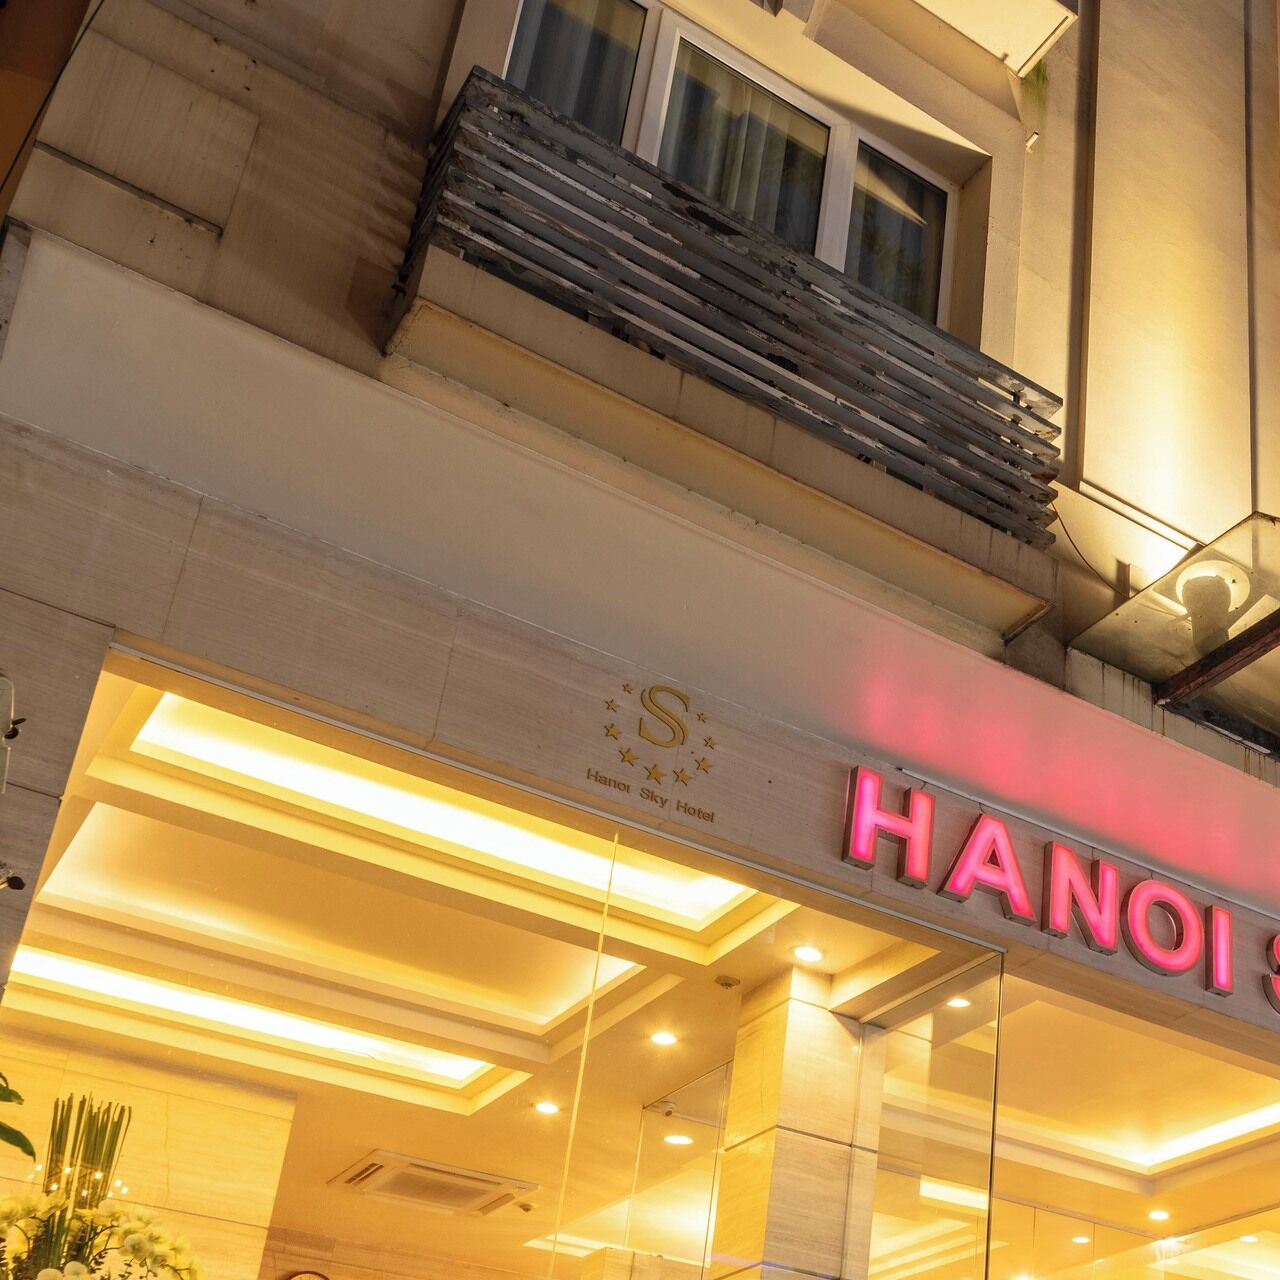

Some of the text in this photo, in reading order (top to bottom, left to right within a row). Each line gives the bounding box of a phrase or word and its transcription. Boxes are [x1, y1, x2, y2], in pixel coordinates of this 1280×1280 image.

[586, 767, 716, 823] Hanoi Sky Hotel
[842, 764, 1234, 998] HANOI
